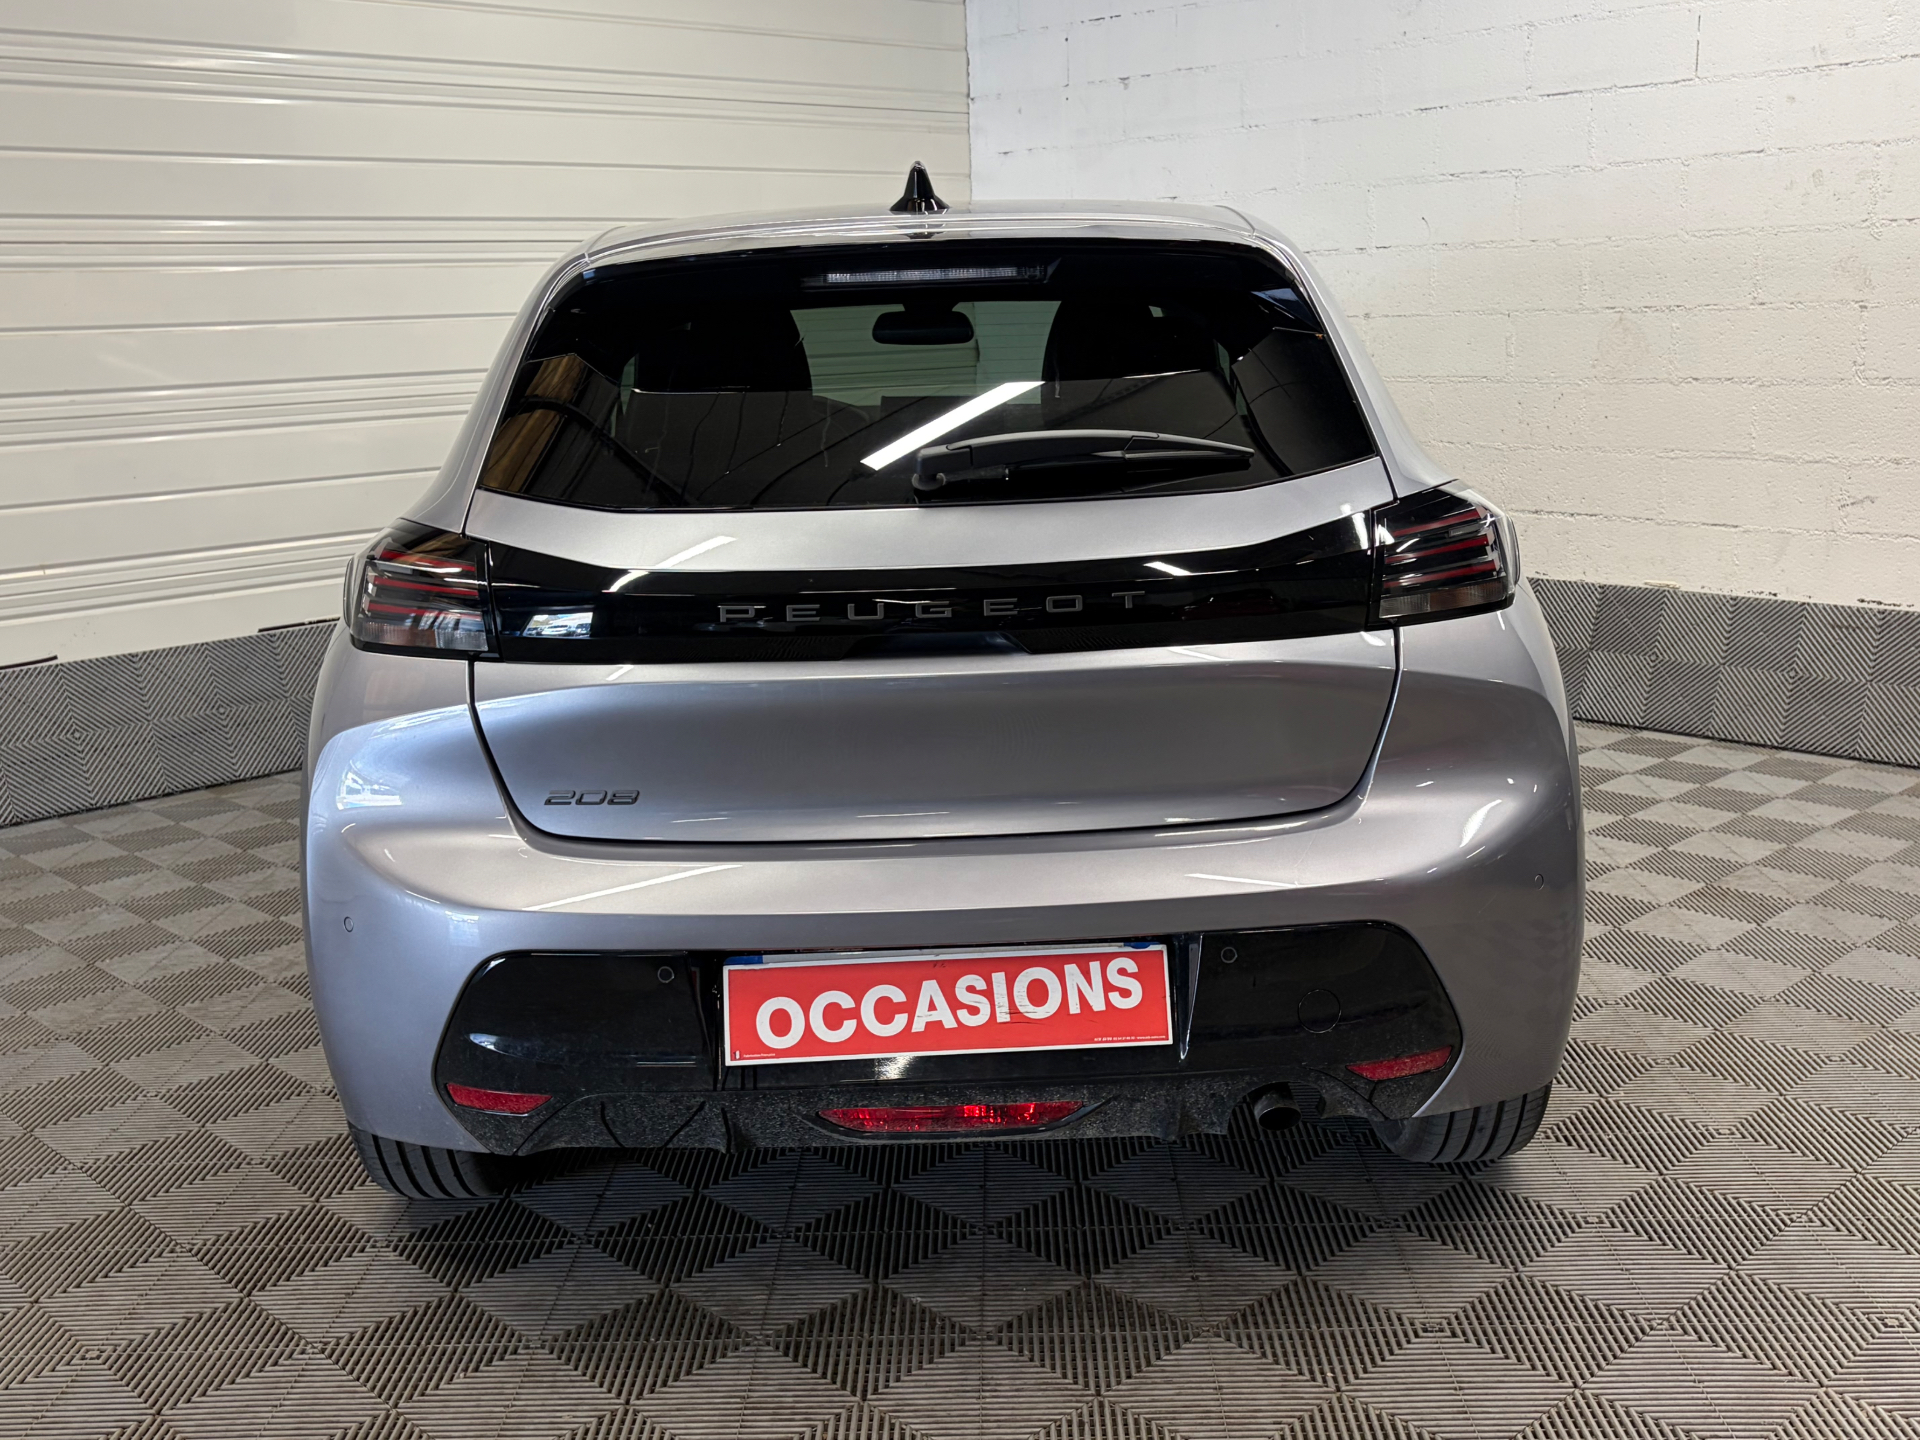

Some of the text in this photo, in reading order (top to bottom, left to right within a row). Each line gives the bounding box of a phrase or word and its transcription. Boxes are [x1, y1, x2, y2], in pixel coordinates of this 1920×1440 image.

[719, 591, 1146, 623] PEUGEOT
[544, 790, 640, 805] 208
[755, 957, 1143, 1049] OCCASIONS
